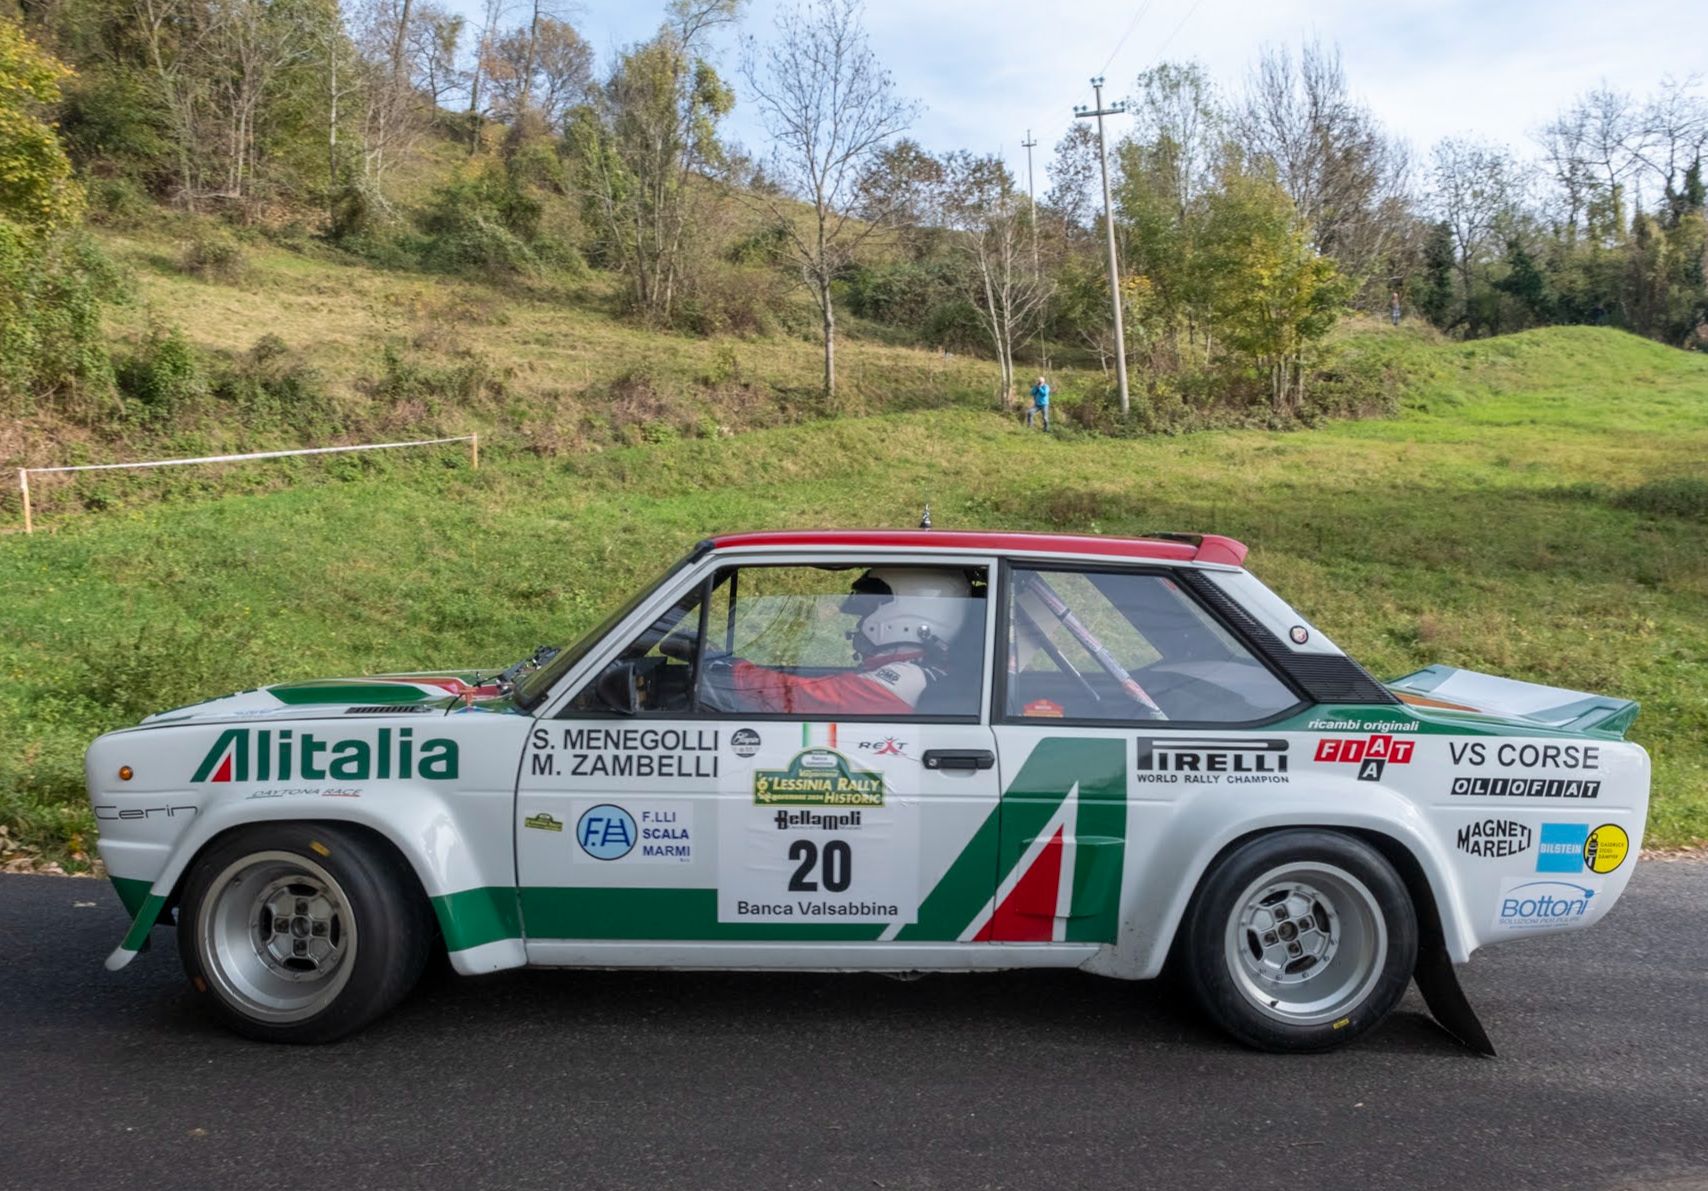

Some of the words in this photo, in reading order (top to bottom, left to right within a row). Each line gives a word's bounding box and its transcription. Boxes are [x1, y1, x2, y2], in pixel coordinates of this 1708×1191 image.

[1308, 719, 1360, 730] ricambi
[1363, 720, 1420, 732] originali
[532, 729, 555, 749] S.
[563, 729, 719, 751] MENEGOLLI
[1314, 735, 1415, 764] FIAT
[190, 728, 459, 783] Alitalia
[1137, 737, 1289, 772] PIRELLI
[1449, 742, 1486, 766] VS
[1498, 744, 1599, 769] CORSE
[531, 754, 561, 776] M.
[571, 754, 718, 777] ZAMBELLI
[773, 777, 832, 791] LESSINIA
[838, 777, 880, 791] RALLY
[1137, 774, 1178, 783] WORLD
[1184, 774, 1221, 783] RALLY
[1227, 774, 1289, 784] CHAMPION
[1452, 778, 1600, 798] OLIOFIAT
[322, 788, 363, 797] RACE
[824, 791, 881, 804] HISTORIC
[642, 811, 676, 823] F.LLI
[774, 810, 861, 830] Bellamoli
[642, 828, 689, 840] SCALA
[1457, 819, 1532, 847] MAGNETI
[643, 845, 690, 857] MARMI
[1540, 843, 1582, 854] BILSTEIN
[788, 840, 852, 892] 20
[737, 901, 793, 916] Banca
[798, 902, 898, 916] Valsabbina
[1501, 896, 1589, 917] Bottoni
